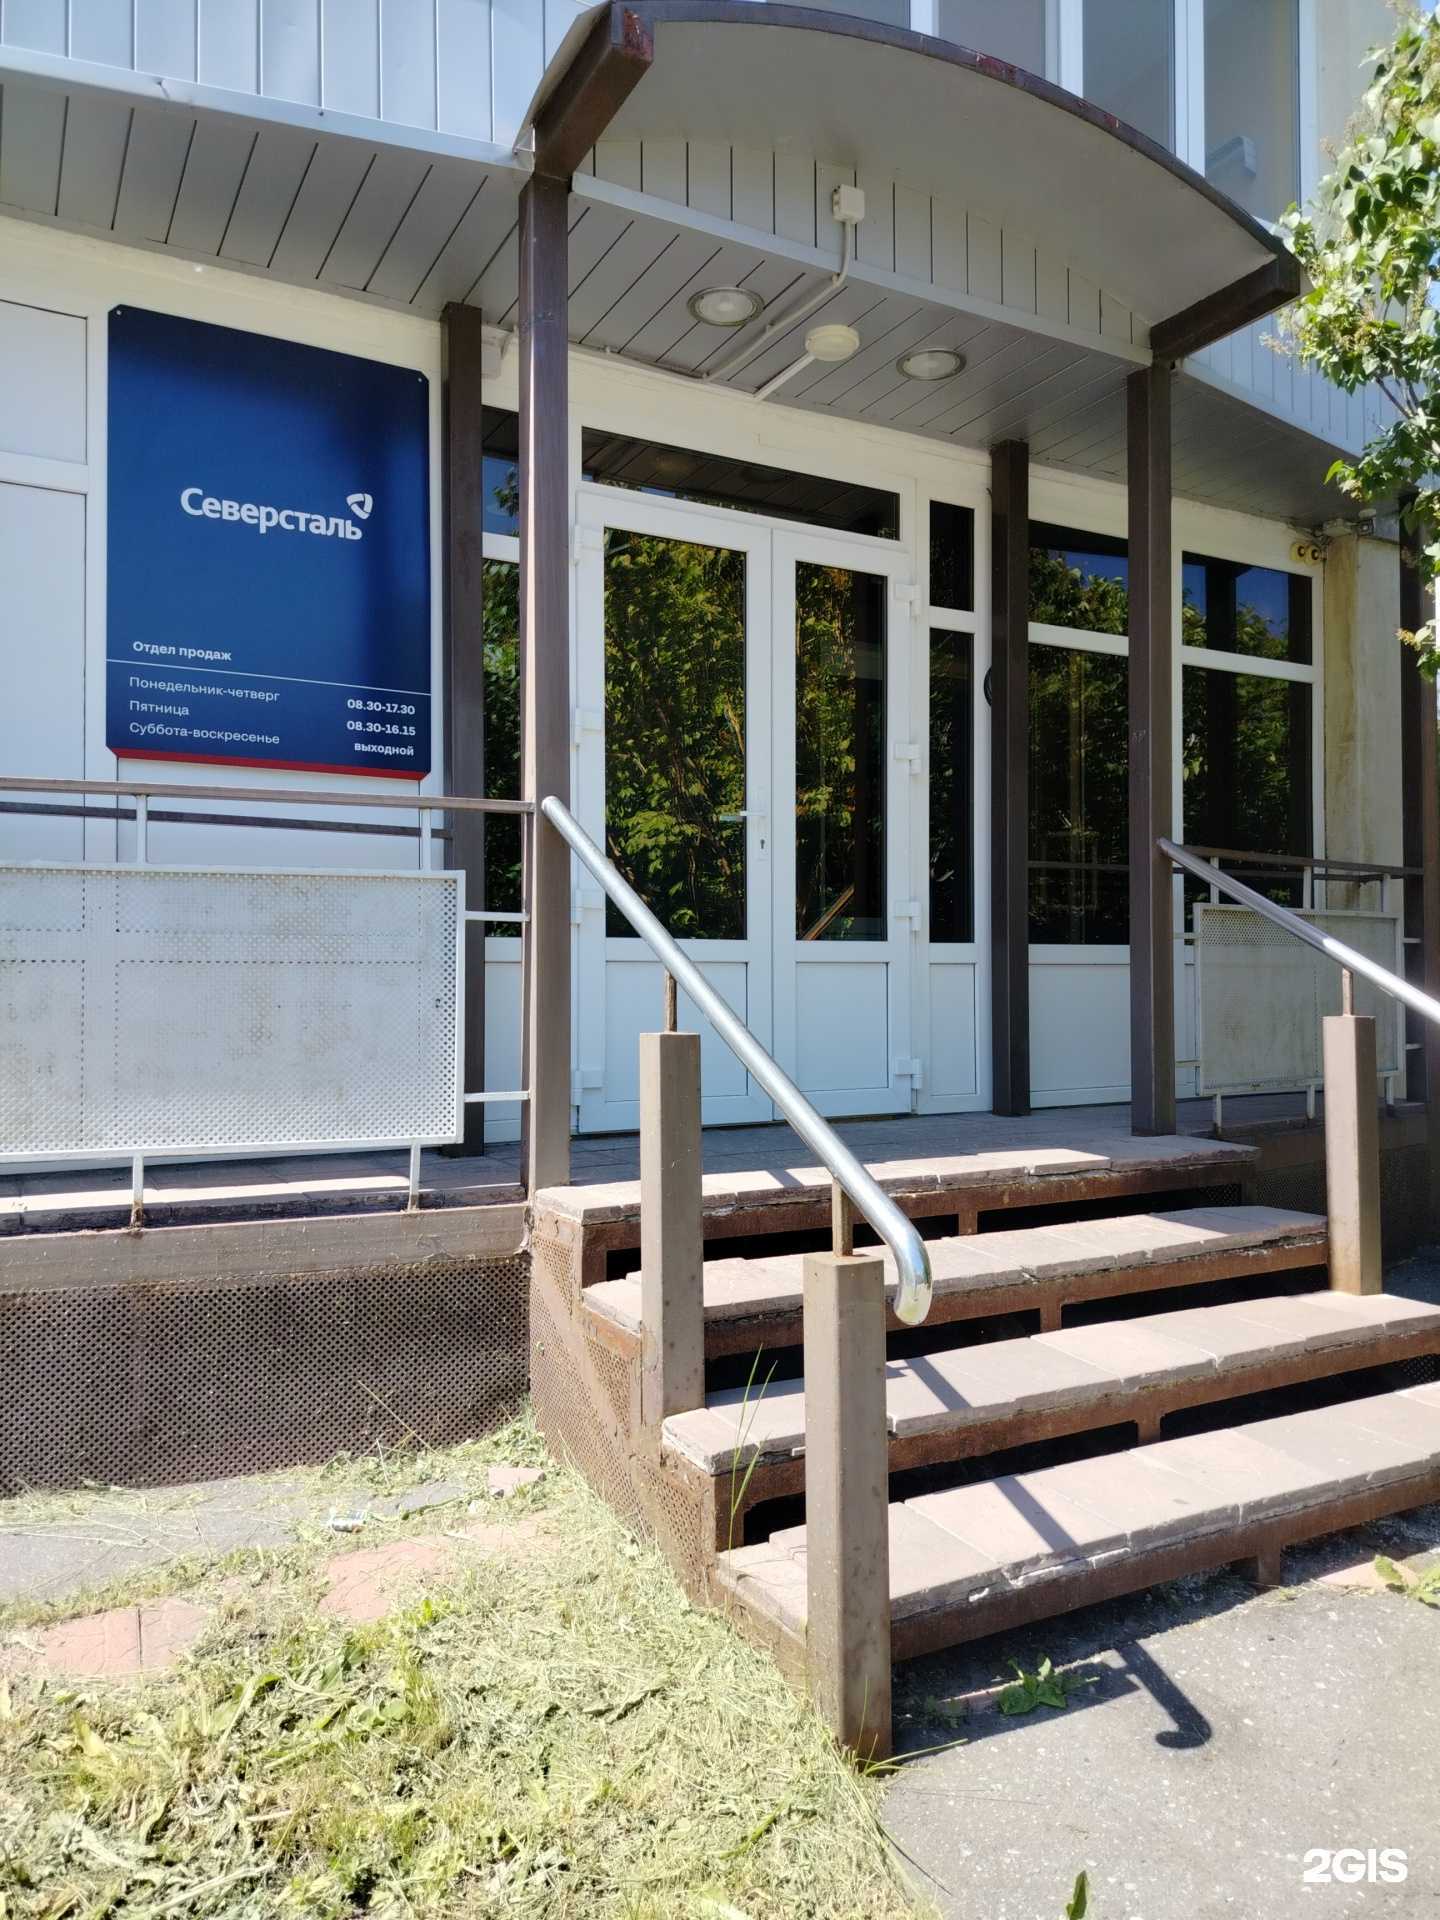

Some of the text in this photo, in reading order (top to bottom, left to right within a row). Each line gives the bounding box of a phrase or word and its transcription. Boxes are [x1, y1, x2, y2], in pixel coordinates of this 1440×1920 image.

[180, 487, 362, 540] Северсталь
[133, 641, 232, 662] Отдел продаж
[129, 676, 416, 716] Понедельник-четверг 08.30-17.30
[129, 700, 416, 736] Пятница 08.30-16.15
[129, 722, 415, 757] Суббота-воскресенье выходной
